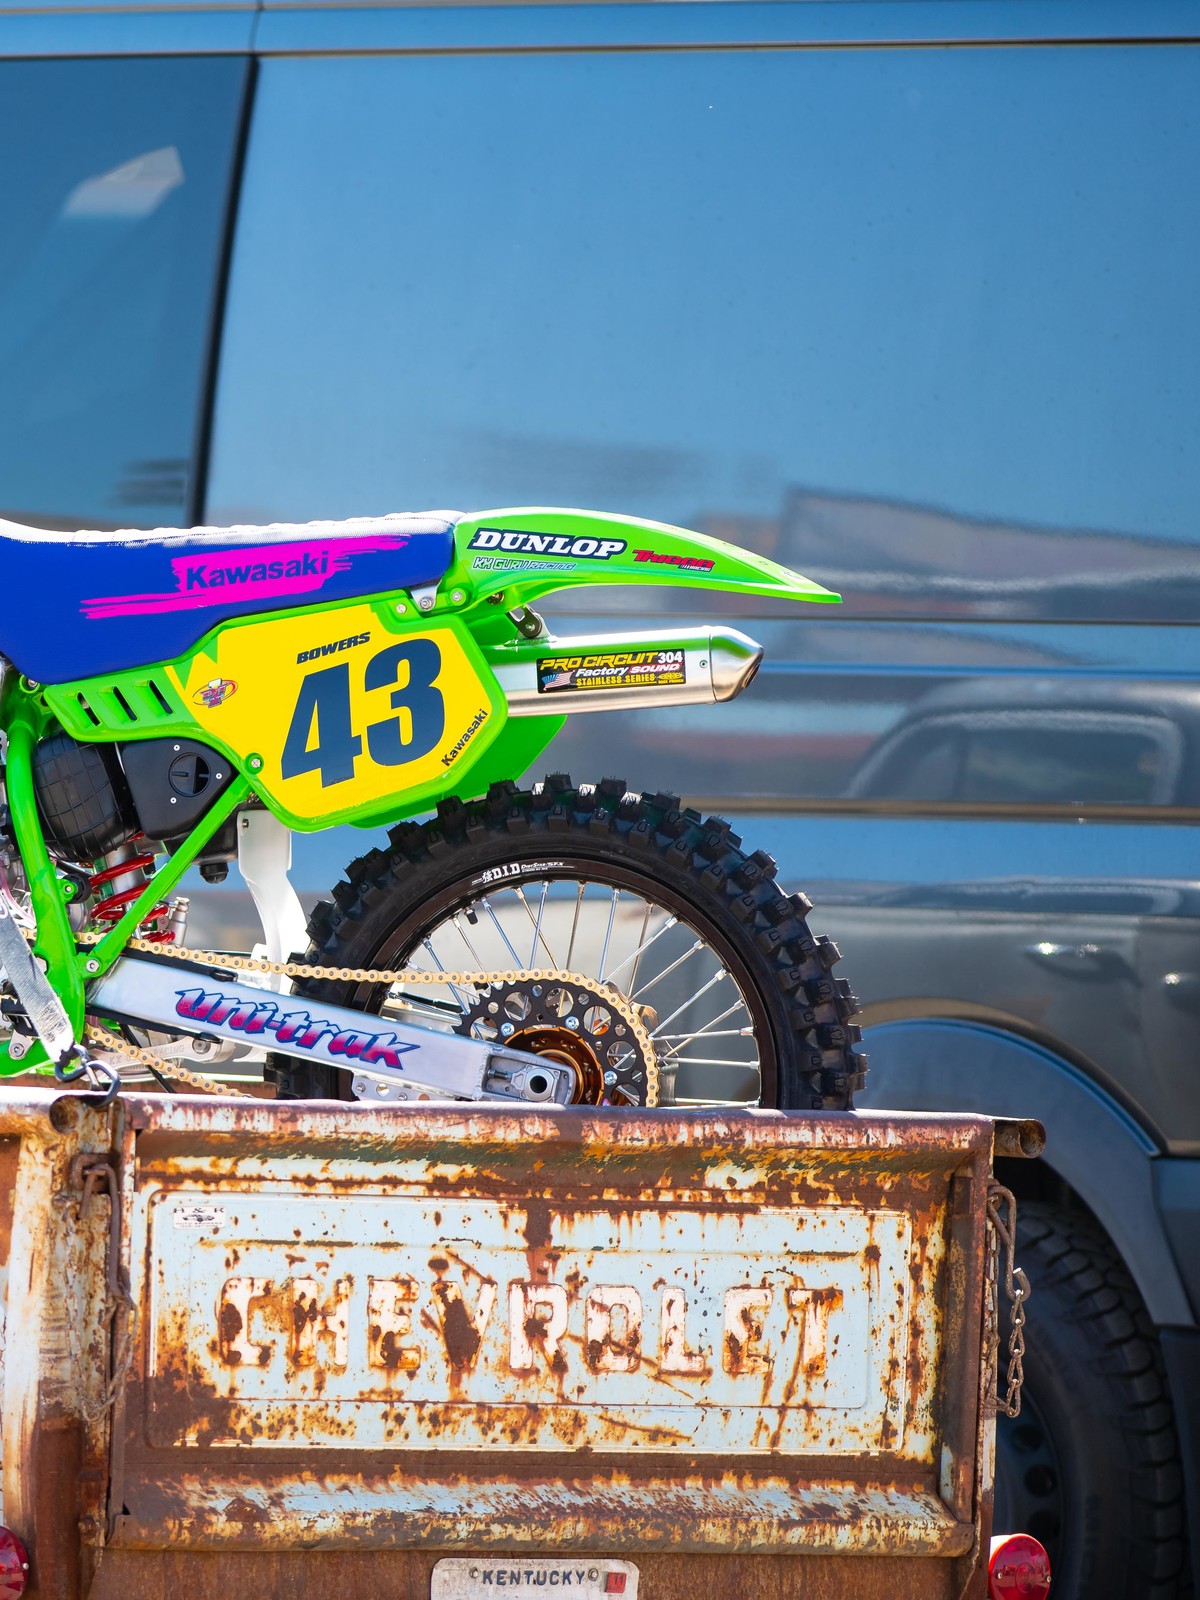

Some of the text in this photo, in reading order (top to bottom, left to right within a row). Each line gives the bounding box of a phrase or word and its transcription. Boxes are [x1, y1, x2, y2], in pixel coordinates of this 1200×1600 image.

[471, 530, 626, 559] DUNLOP
[186, 551, 329, 591] Kawasaki
[473, 557, 577, 571] KX GURU RACING
[296, 631, 371, 664] BOWERS
[540, 651, 683, 671] PRO CIRCUIT 304
[575, 663, 681, 678] Factory SOUND
[576, 676, 623, 686] STAINLESS
[625, 673, 655, 683] SERIES
[280, 638, 446, 789] 43
[441, 708, 488, 767] Kawasaki
[492, 863, 521, 879] D.I.D
[173, 987, 422, 1070] uni-trak
[215, 1274, 846, 1377] CHEVROLET
[481, 1569, 586, 1586] KENTUCKY
